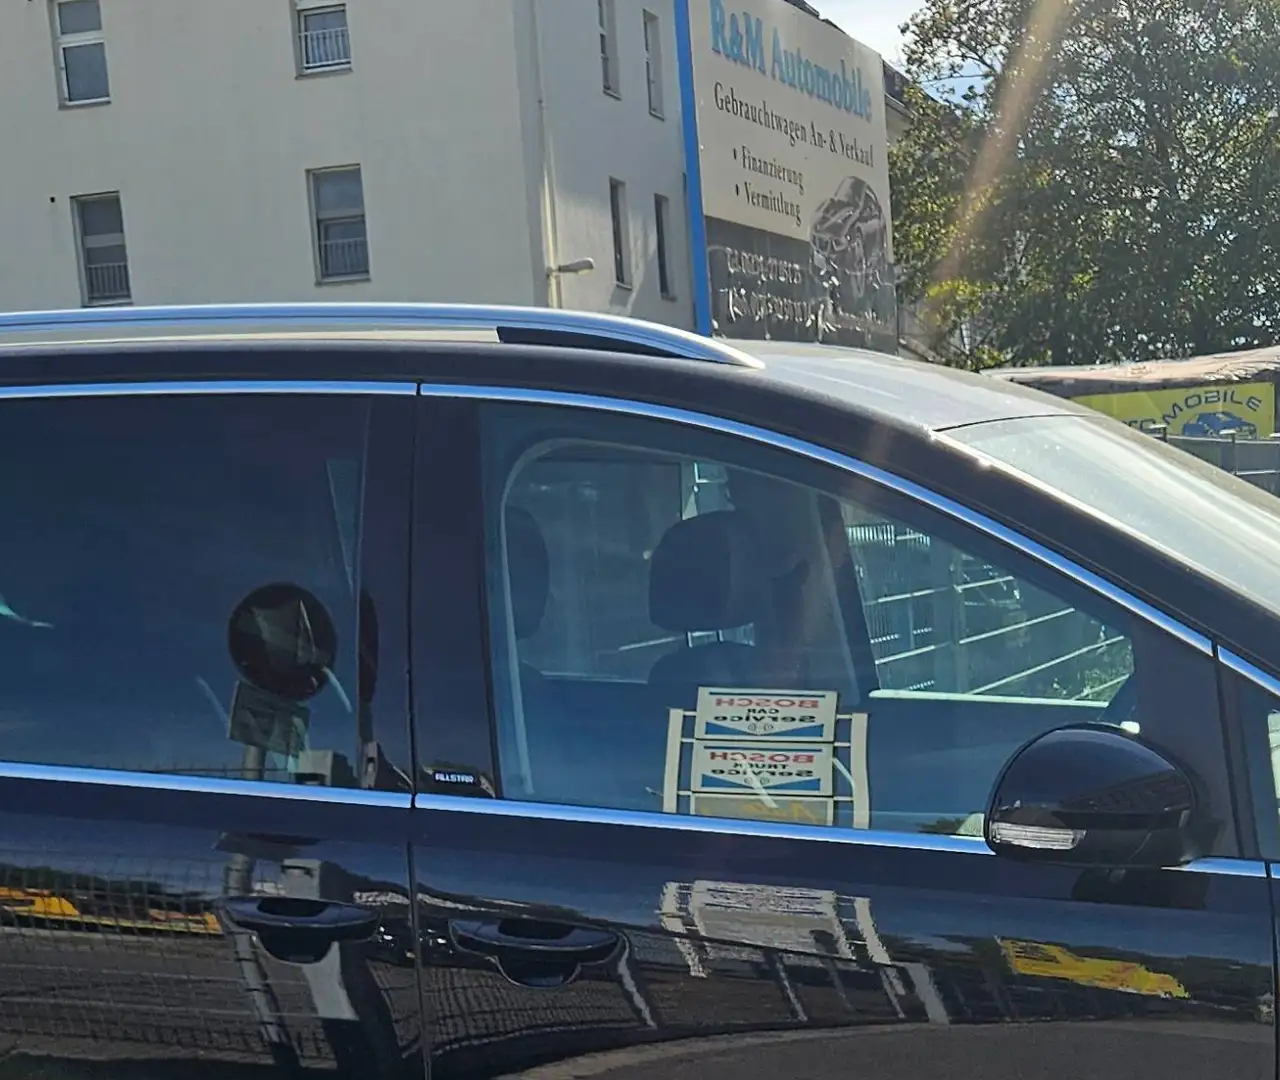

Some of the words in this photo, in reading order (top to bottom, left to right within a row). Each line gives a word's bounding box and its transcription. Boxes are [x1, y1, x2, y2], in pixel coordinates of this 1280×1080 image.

[709, 0, 766, 76] R&M
[771, 26, 873, 122] Automobile
[713, 81, 807, 148] Gebrauchtwagen
[810, 120, 827, 149] An-
[829, 129, 837, 154] &
[838, 131, 874, 168] Verkauf
[740, 145, 804, 196] Finanzierung
[743, 180, 802, 228] Vermittlung
